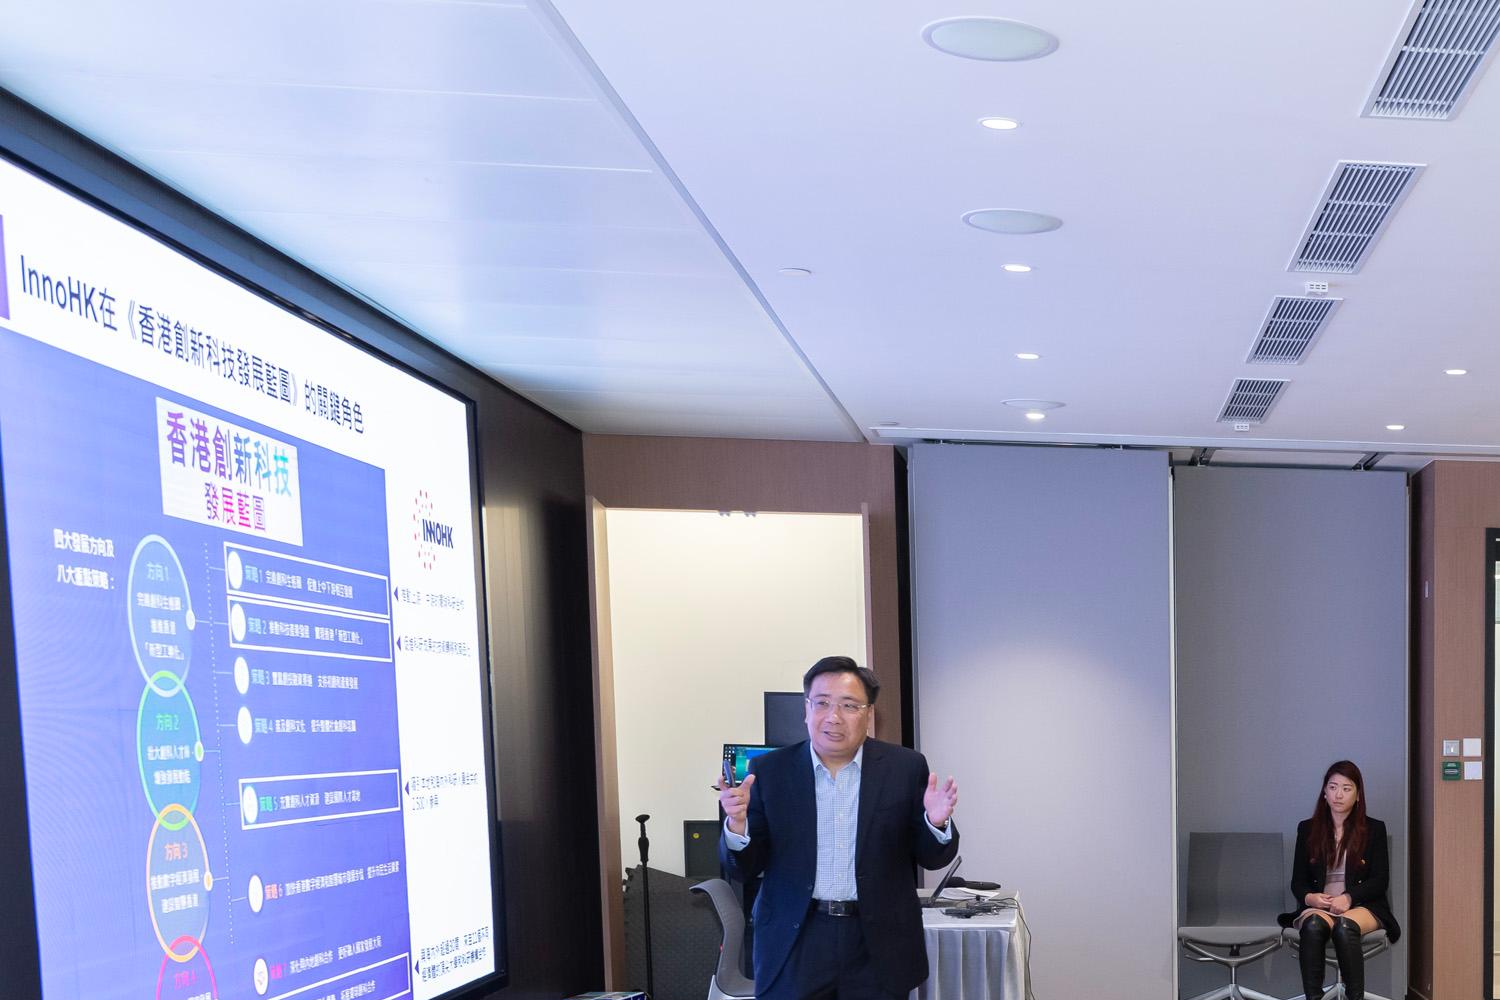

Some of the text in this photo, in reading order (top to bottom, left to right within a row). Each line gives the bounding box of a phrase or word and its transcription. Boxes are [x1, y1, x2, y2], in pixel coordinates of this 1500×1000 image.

[166, 411, 292, 498] 香港創新科技
[204, 483, 266, 532] 發展藍圖
[422, 518, 453, 550] INNOHK
